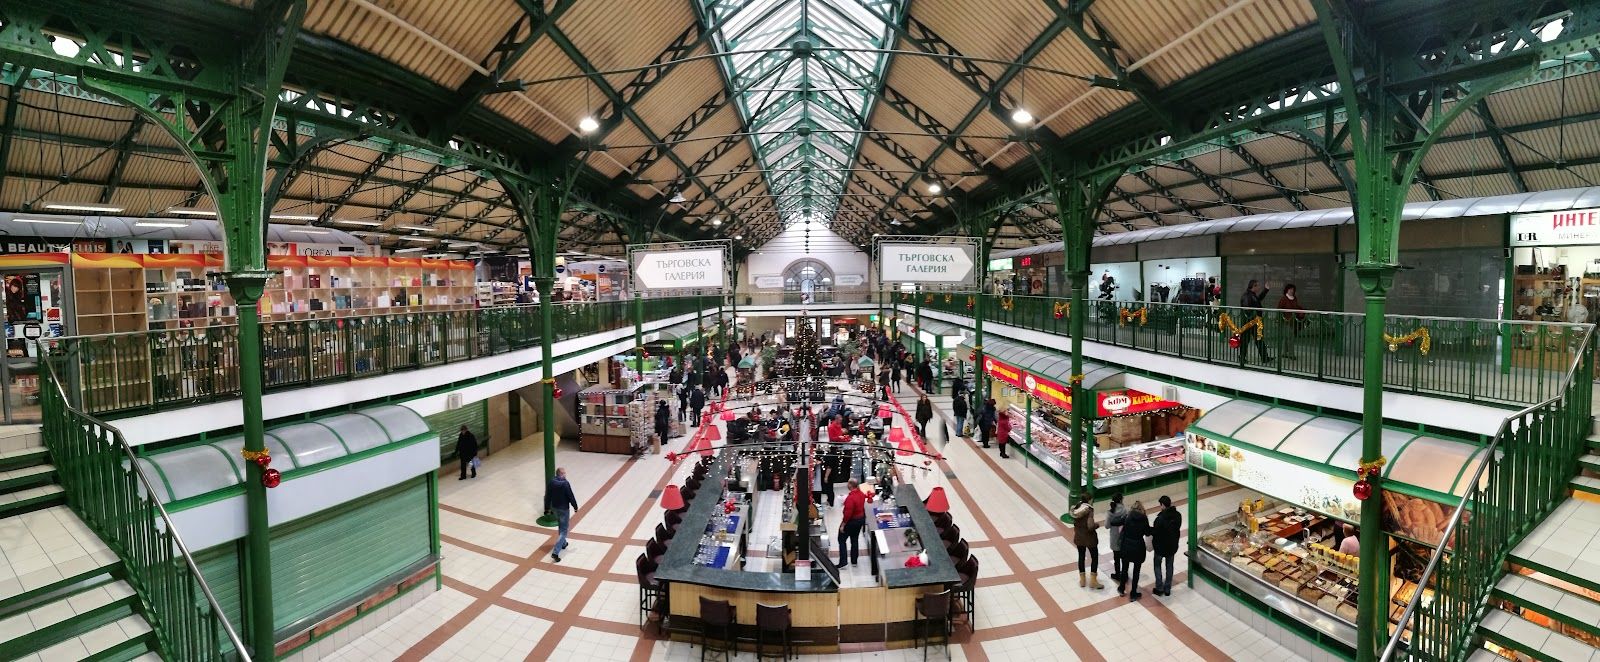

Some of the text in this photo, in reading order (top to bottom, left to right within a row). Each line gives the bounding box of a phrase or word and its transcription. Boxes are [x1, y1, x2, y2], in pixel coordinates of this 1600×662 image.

[1553, 211, 1600, 230] ИНТЕ
[8, 243, 65, 253] BEAUTY
[898, 253, 955, 262] ТЪРГОВСКА
[656, 258, 712, 268] ТЪРГОВСКА
[906, 265, 947, 273] ГАЛЕРИЯ
[665, 271, 705, 280] ГАЛЕРИЯ
